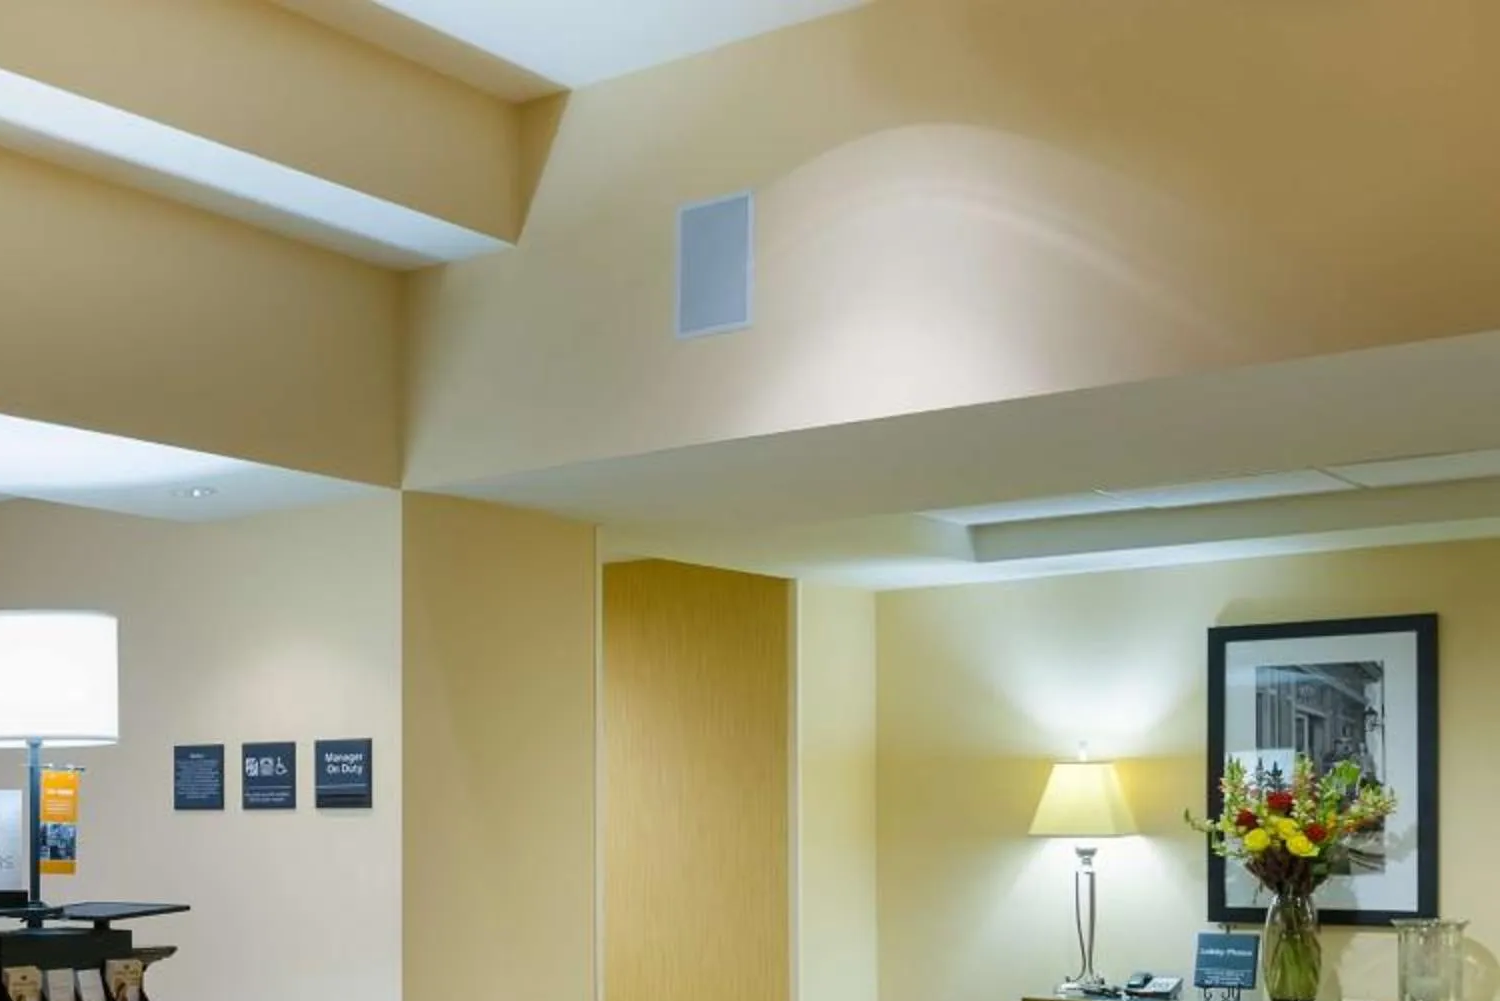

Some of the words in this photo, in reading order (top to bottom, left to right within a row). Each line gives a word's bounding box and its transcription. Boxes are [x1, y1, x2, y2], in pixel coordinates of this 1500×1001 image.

[325, 752, 363, 764] Manager
[327, 764, 340, 774] On
[341, 763, 363, 775] Duty
